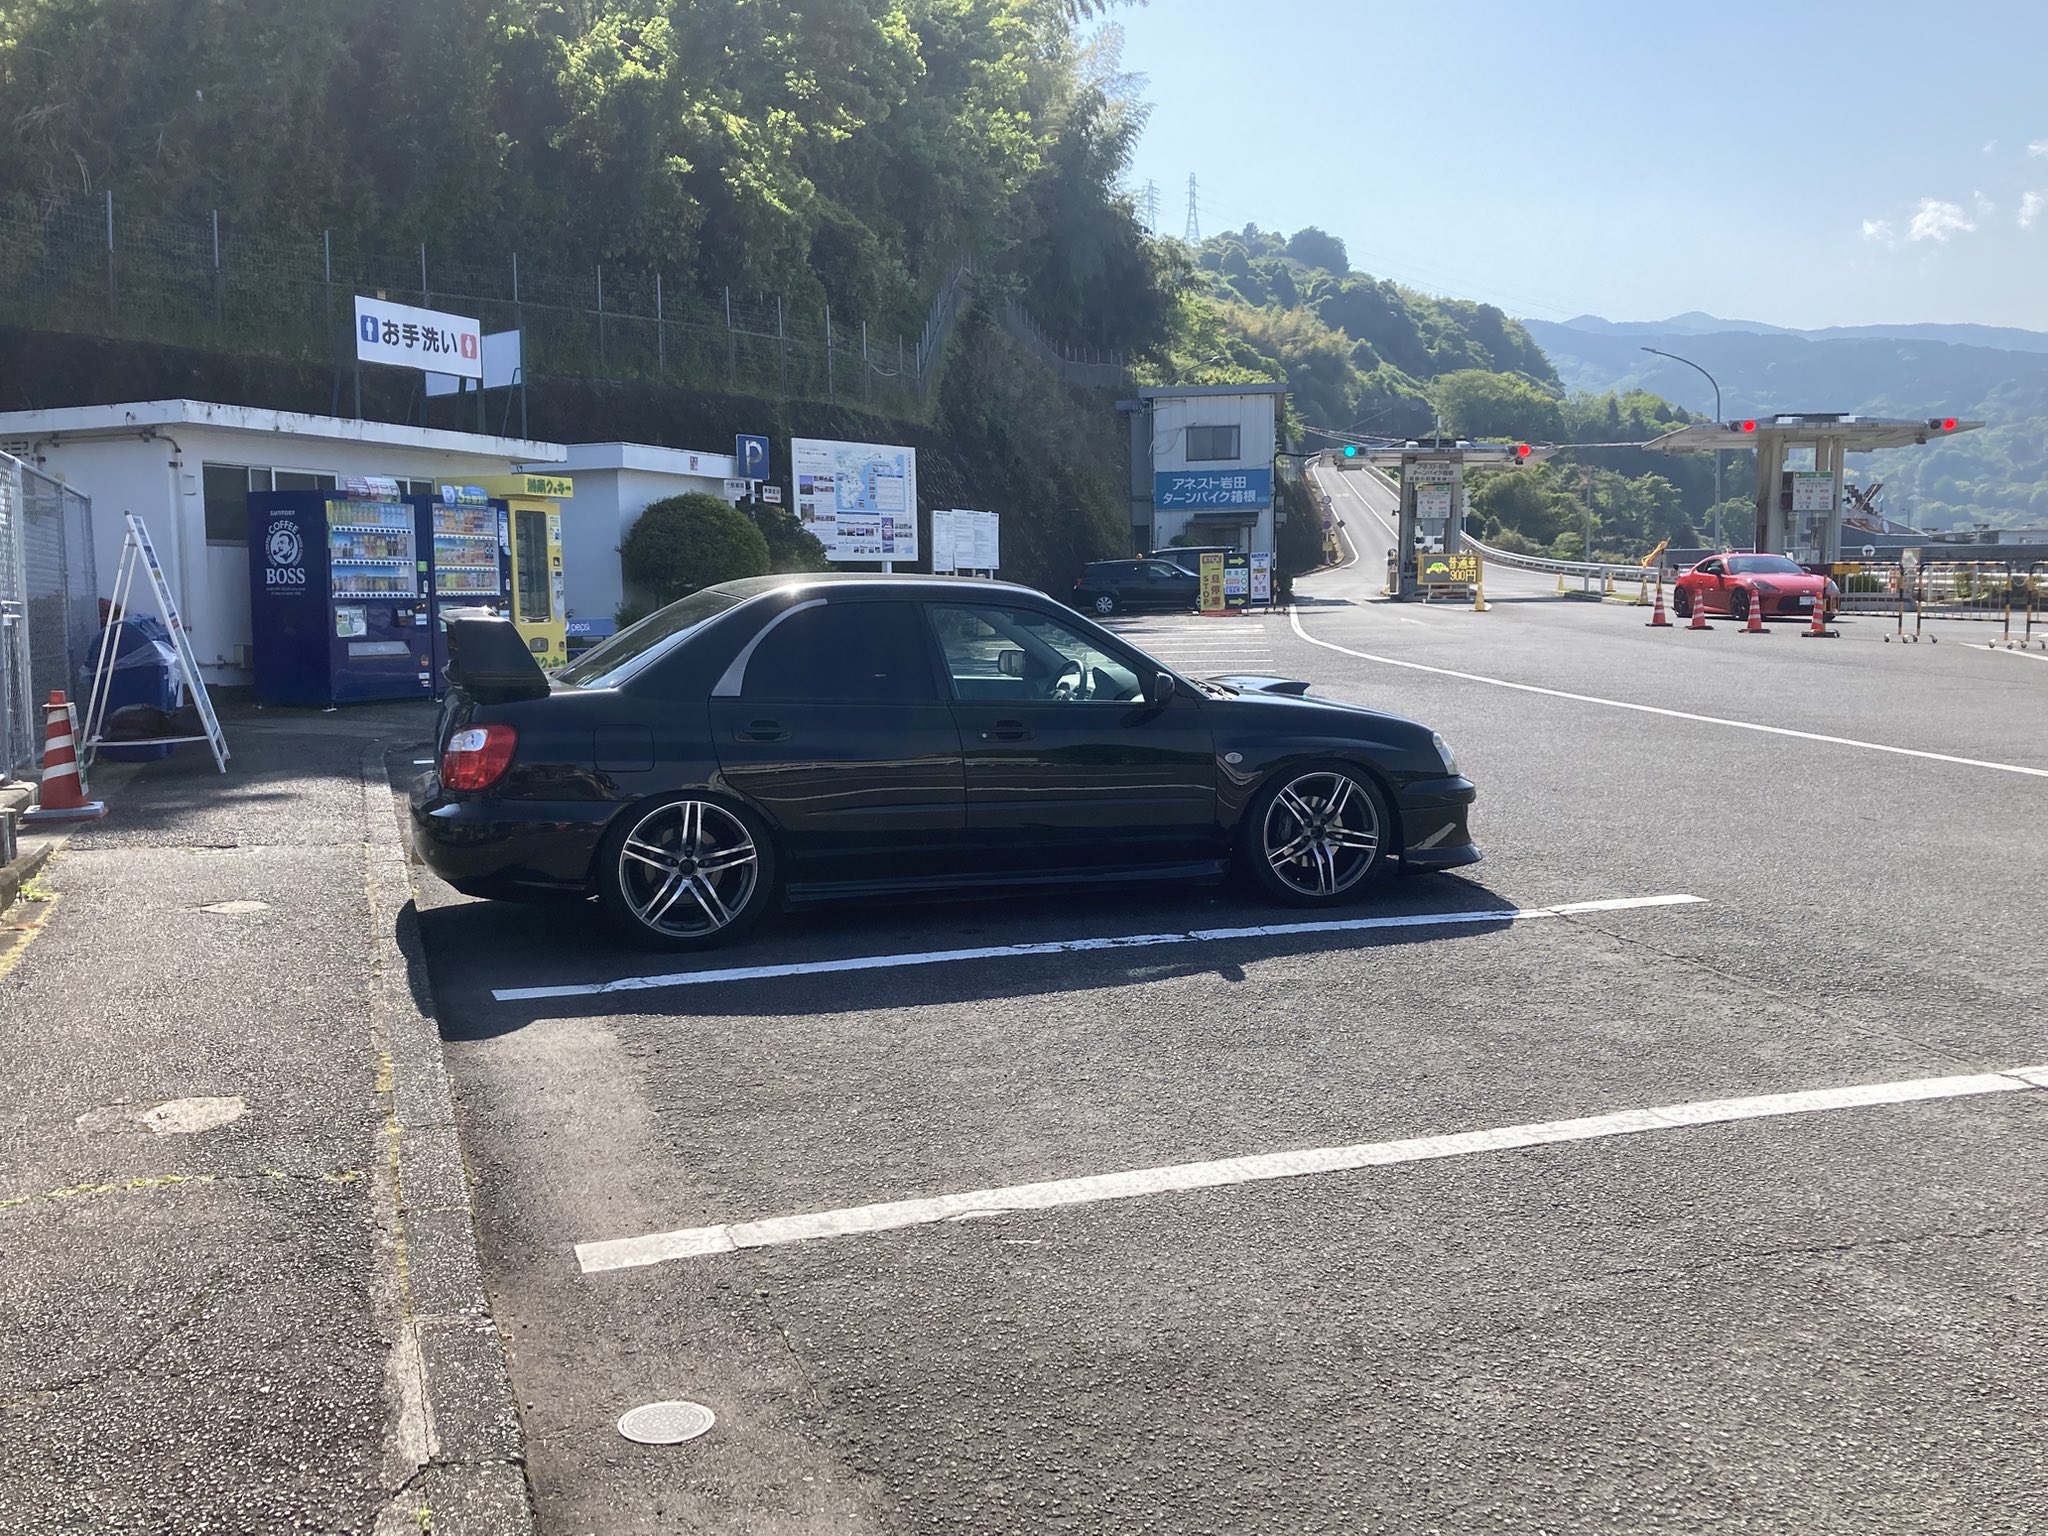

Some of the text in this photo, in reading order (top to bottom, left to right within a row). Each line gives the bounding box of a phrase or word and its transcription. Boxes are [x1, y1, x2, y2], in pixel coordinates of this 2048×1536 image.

[382, 319, 457, 353] お手洗い
[745, 440, 763, 474] P
[1172, 476, 1247, 490] アネスト岩田
[1163, 489, 1256, 505] ターンバイク箱根
[268, 520, 299, 534] COFFEE
[1448, 556, 1477, 569] 普通車
[266, 567, 306, 584] BOSS
[570, 623, 590, 632] pepsi
